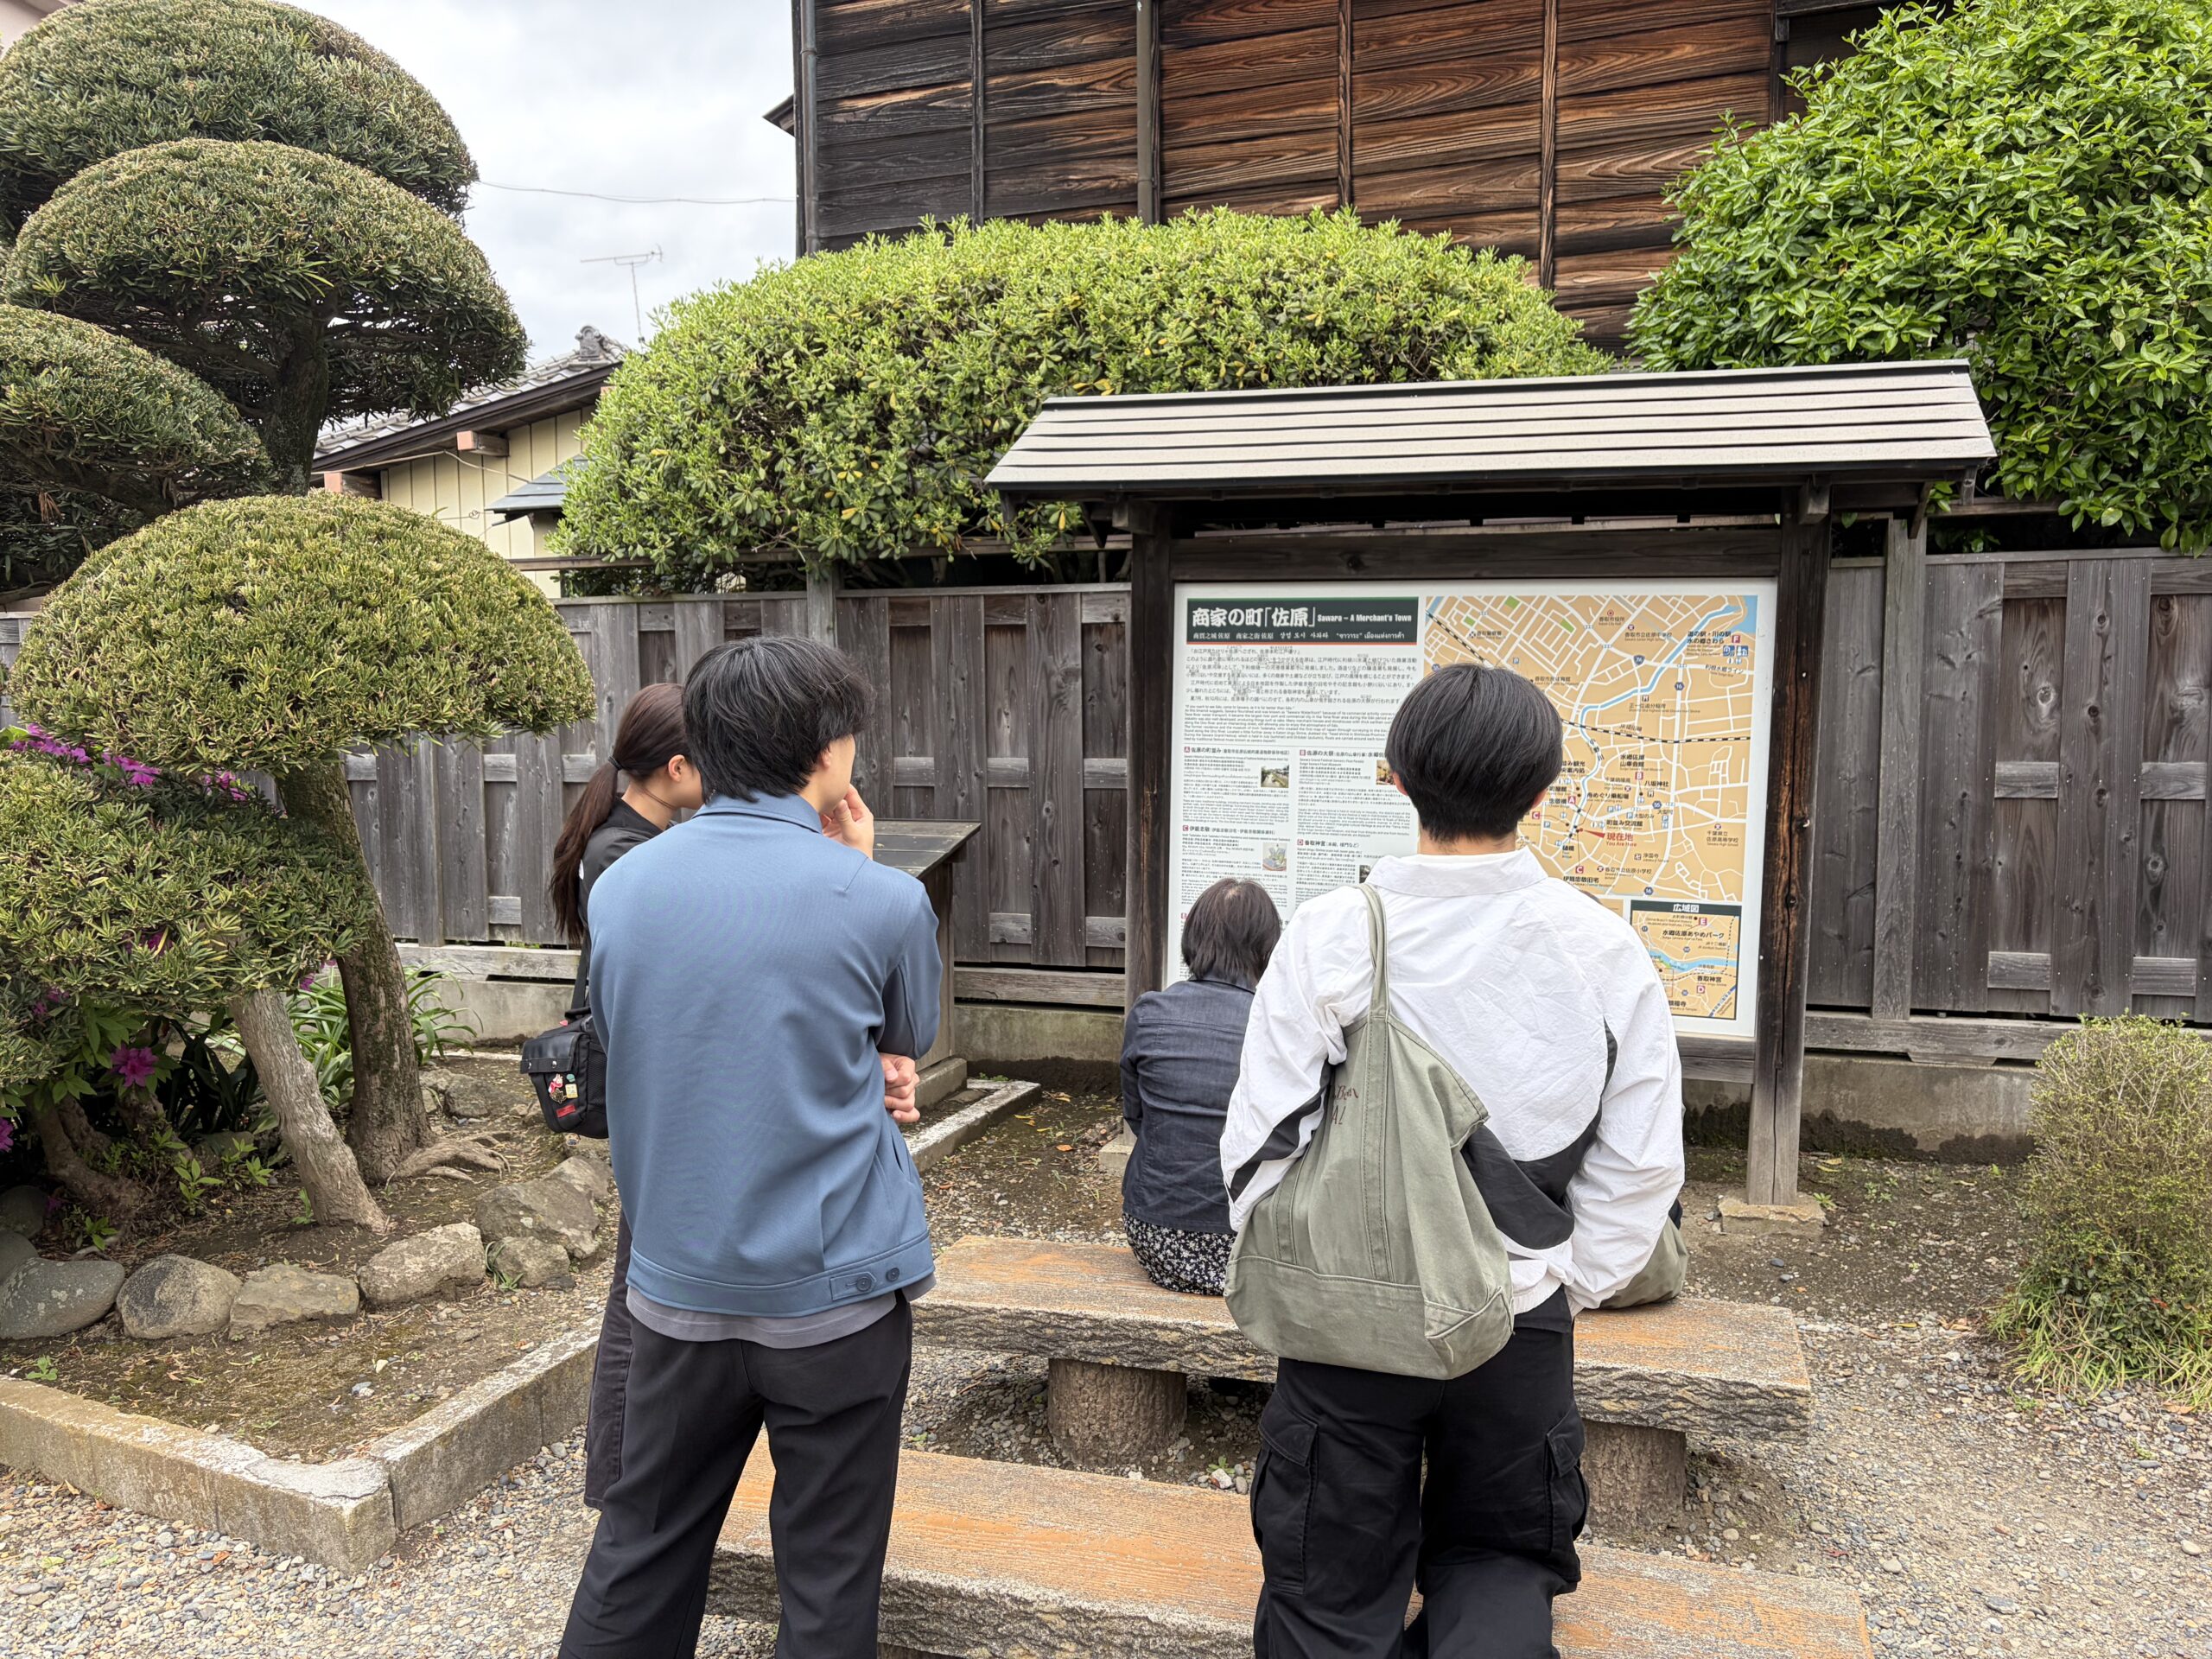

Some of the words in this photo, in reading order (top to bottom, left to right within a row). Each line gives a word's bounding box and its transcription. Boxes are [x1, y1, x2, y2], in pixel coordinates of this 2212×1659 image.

[1192, 607, 1316, 627] 商家の町「佐原」
[1317, 613, 1342, 622] Sawara
[1350, 613, 1355, 622] A
[1356, 613, 1392, 622] Merchant's
[1395, 613, 1412, 622] Town
[1607, 832, 1633, 841] 現在地
